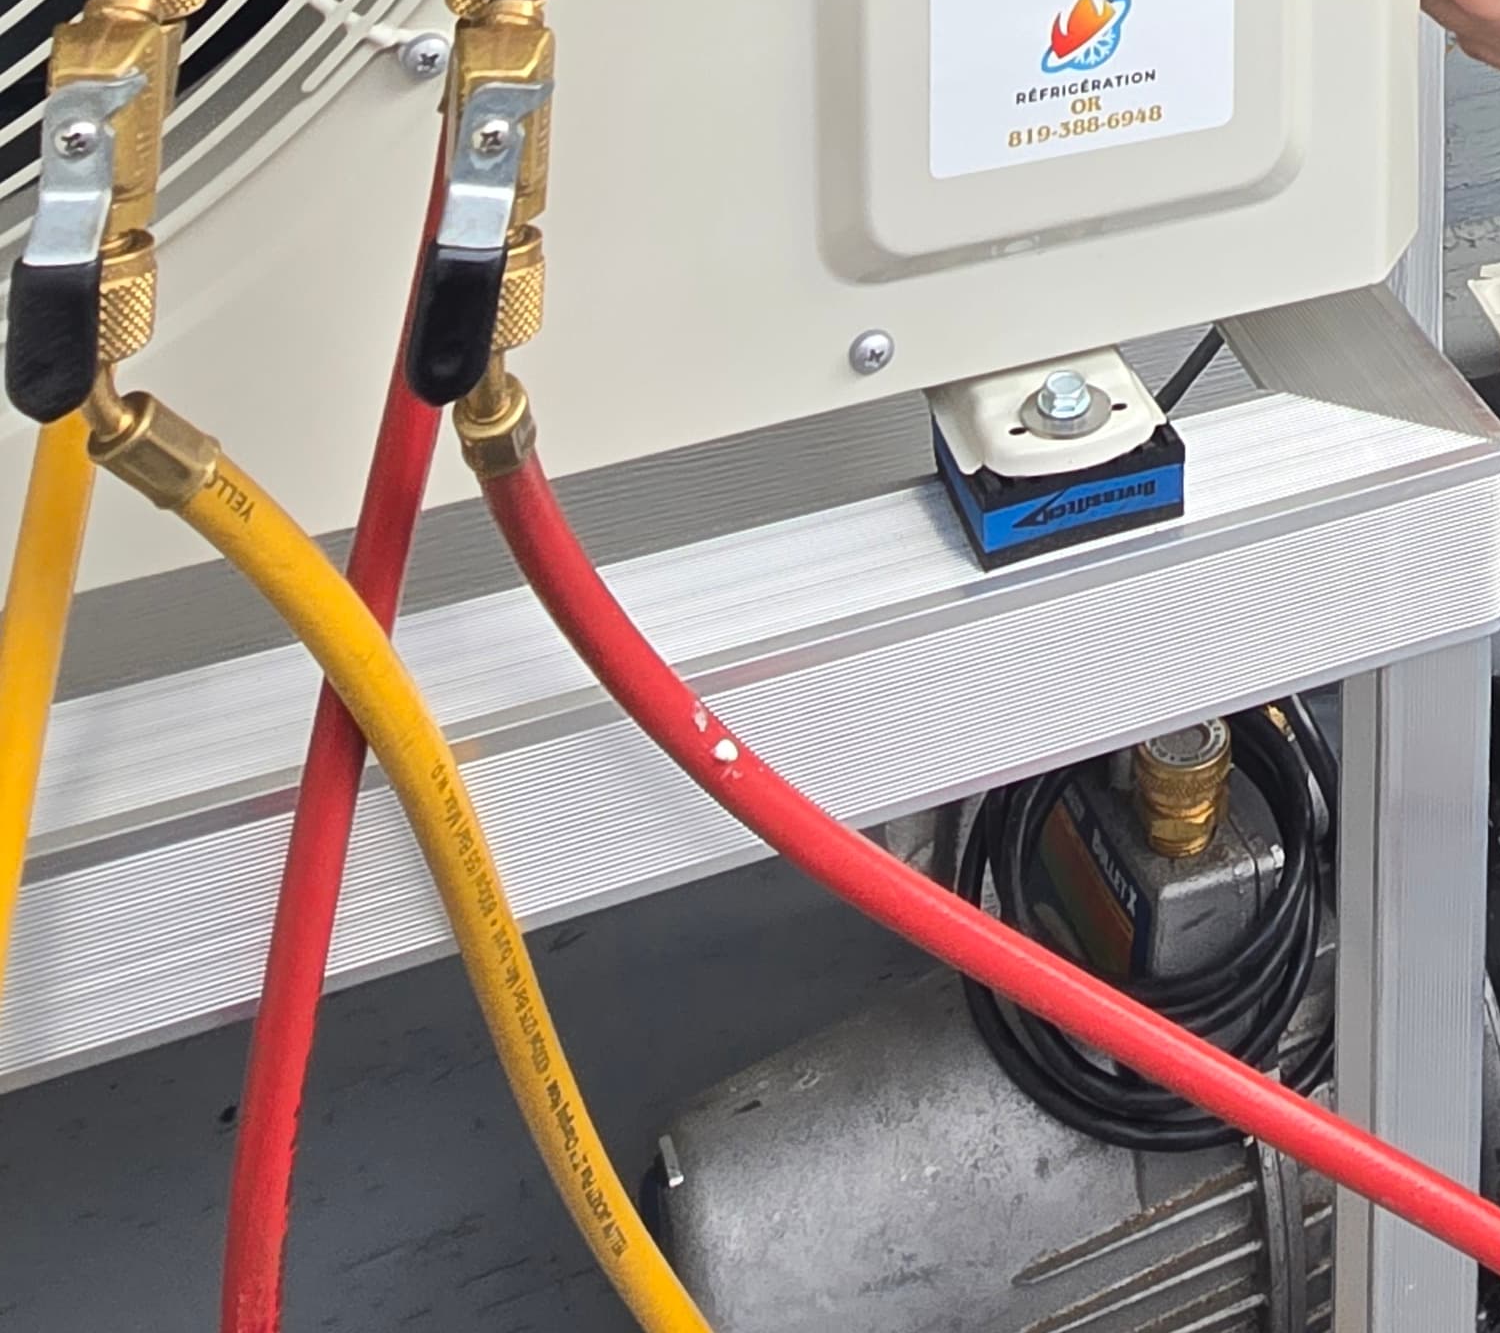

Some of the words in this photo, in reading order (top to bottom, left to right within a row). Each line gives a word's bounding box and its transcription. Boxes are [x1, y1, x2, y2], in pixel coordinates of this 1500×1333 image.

[1015, 67, 1158, 106] RÉFRIGÉRATION
[1069, 94, 1103, 116] OR
[1006, 103, 1164, 150] 819-388-6948
